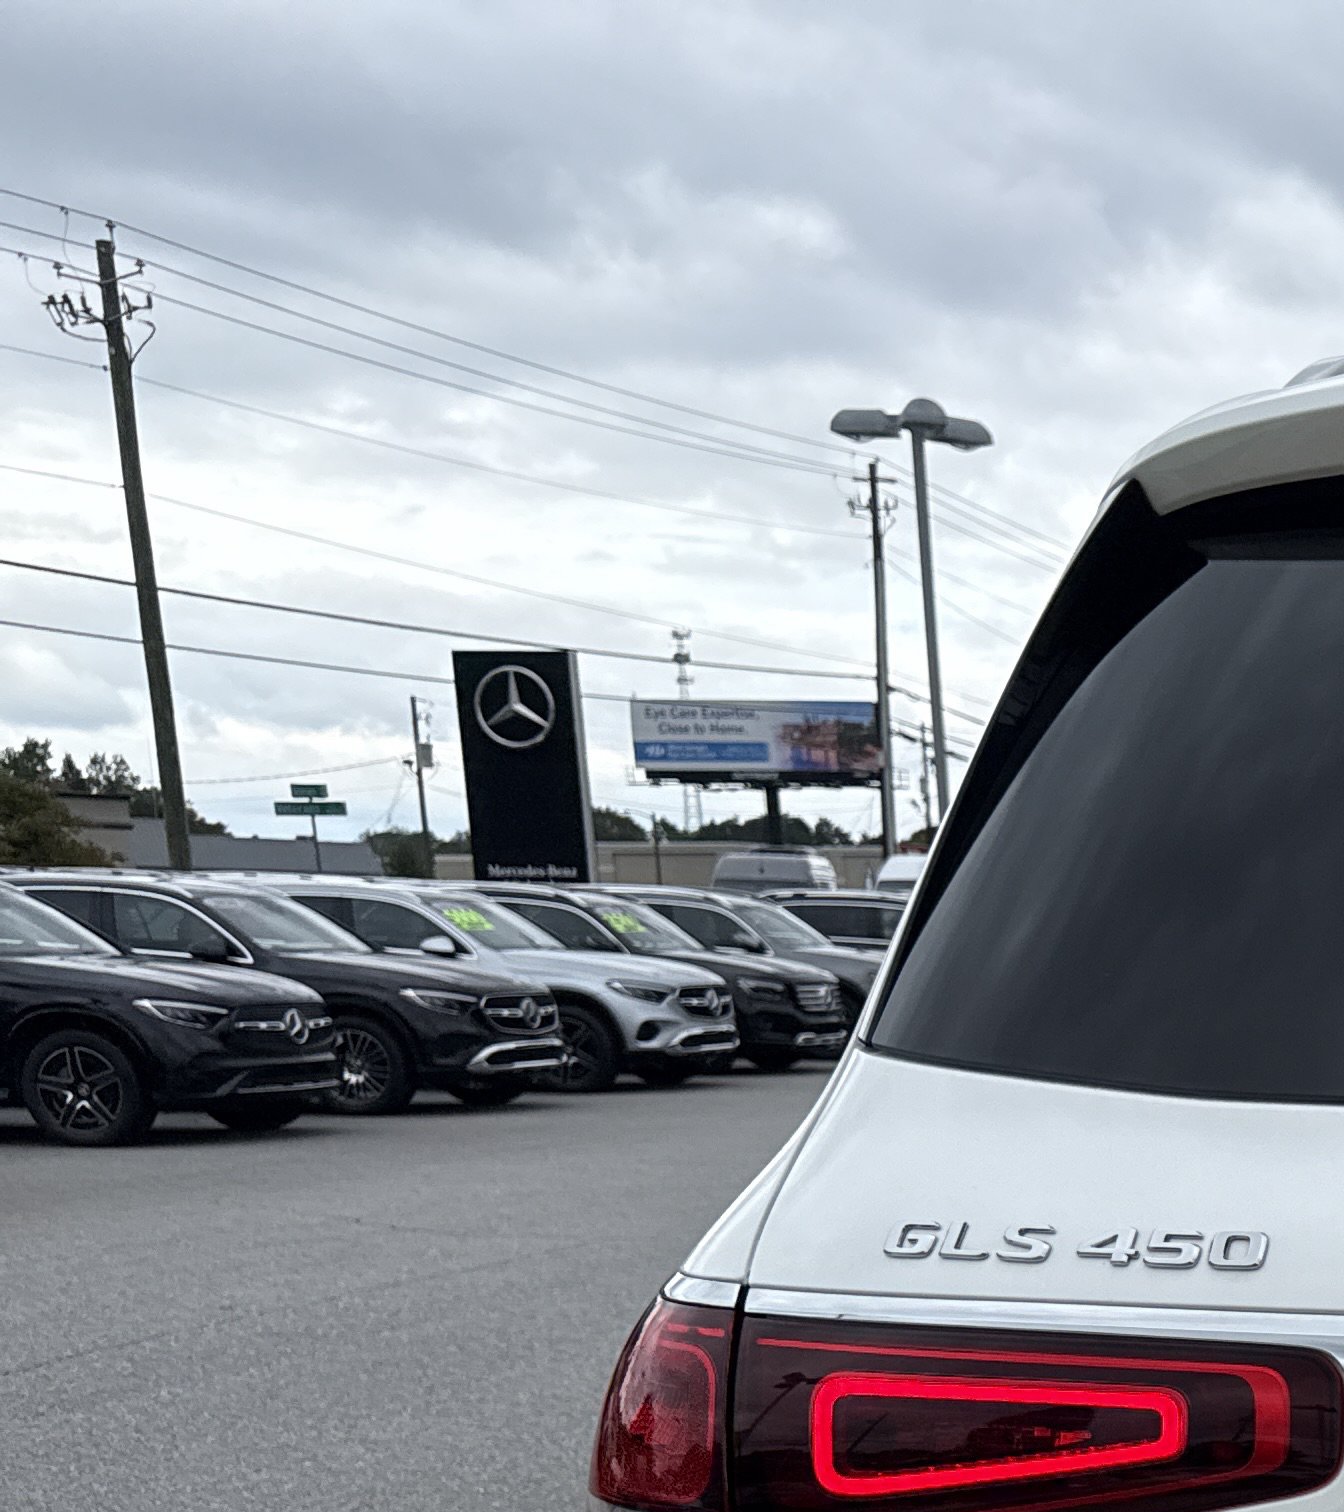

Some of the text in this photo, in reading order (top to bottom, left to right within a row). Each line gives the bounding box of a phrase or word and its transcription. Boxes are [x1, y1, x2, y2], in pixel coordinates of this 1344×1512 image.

[644, 705, 667, 721] Eye
[670, 705, 698, 720] Care
[883, 1220, 1270, 1270] GLS 450
